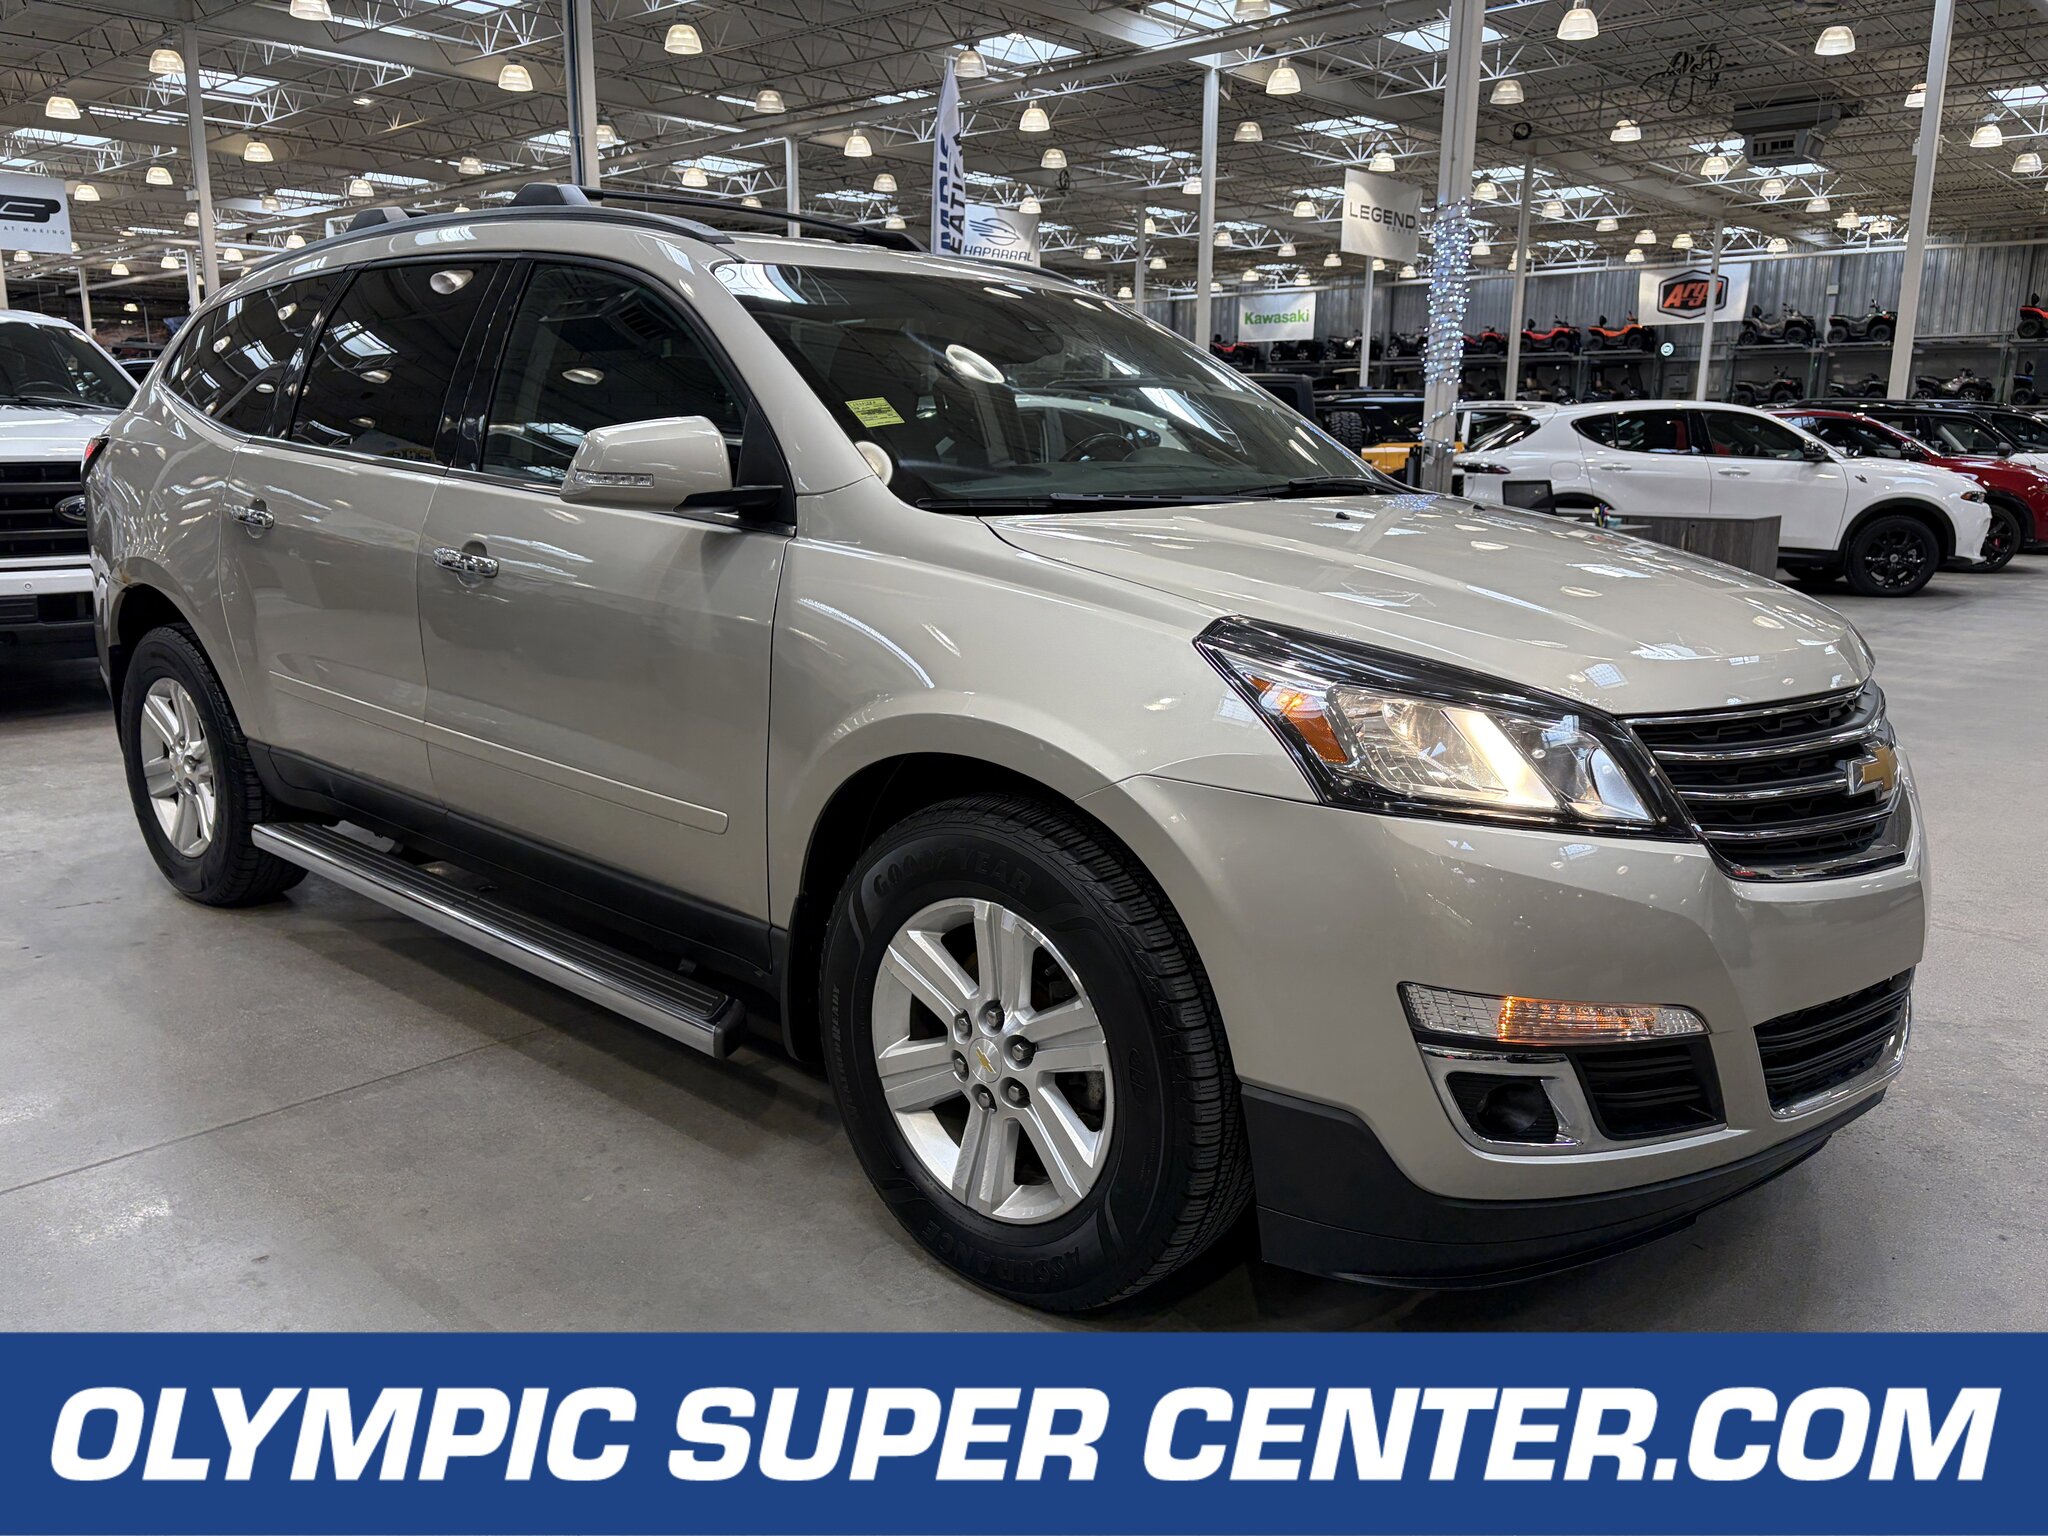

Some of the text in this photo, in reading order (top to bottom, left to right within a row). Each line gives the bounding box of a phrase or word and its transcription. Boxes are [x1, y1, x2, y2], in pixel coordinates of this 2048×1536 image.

[1350, 202, 1416, 229] LEGEND
[23, 227, 65, 235] MAKING
[964, 244, 1034, 262] HAPARRAL
[1244, 309, 1310, 326] Kawasaki
